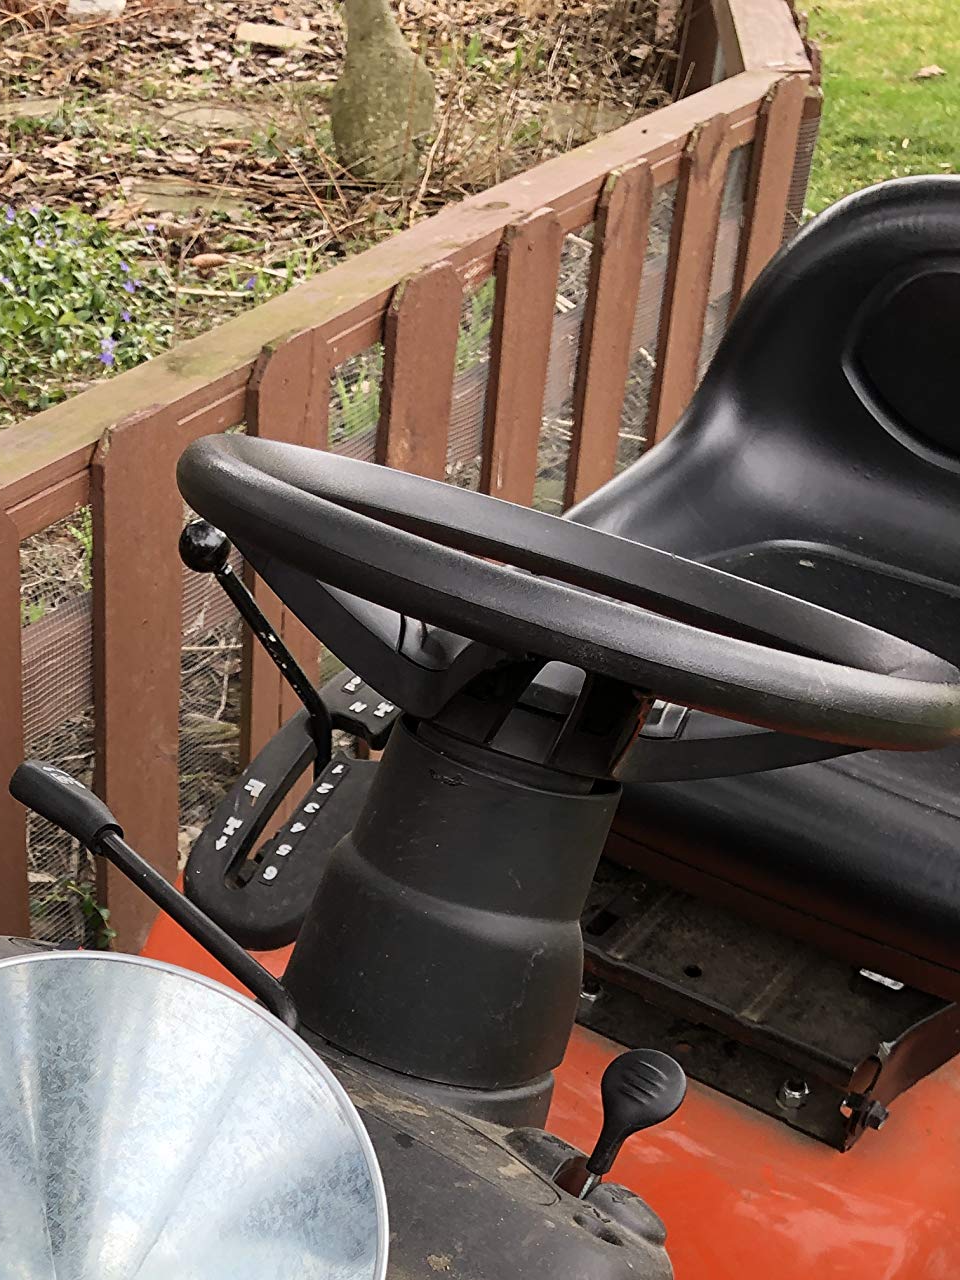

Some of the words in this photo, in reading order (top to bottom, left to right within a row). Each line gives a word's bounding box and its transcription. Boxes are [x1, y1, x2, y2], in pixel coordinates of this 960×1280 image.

[316, 782, 334, 794] 2
[303, 802, 320, 813] 3
[275, 844, 293, 856] 5
[262, 865, 278, 880] 6
